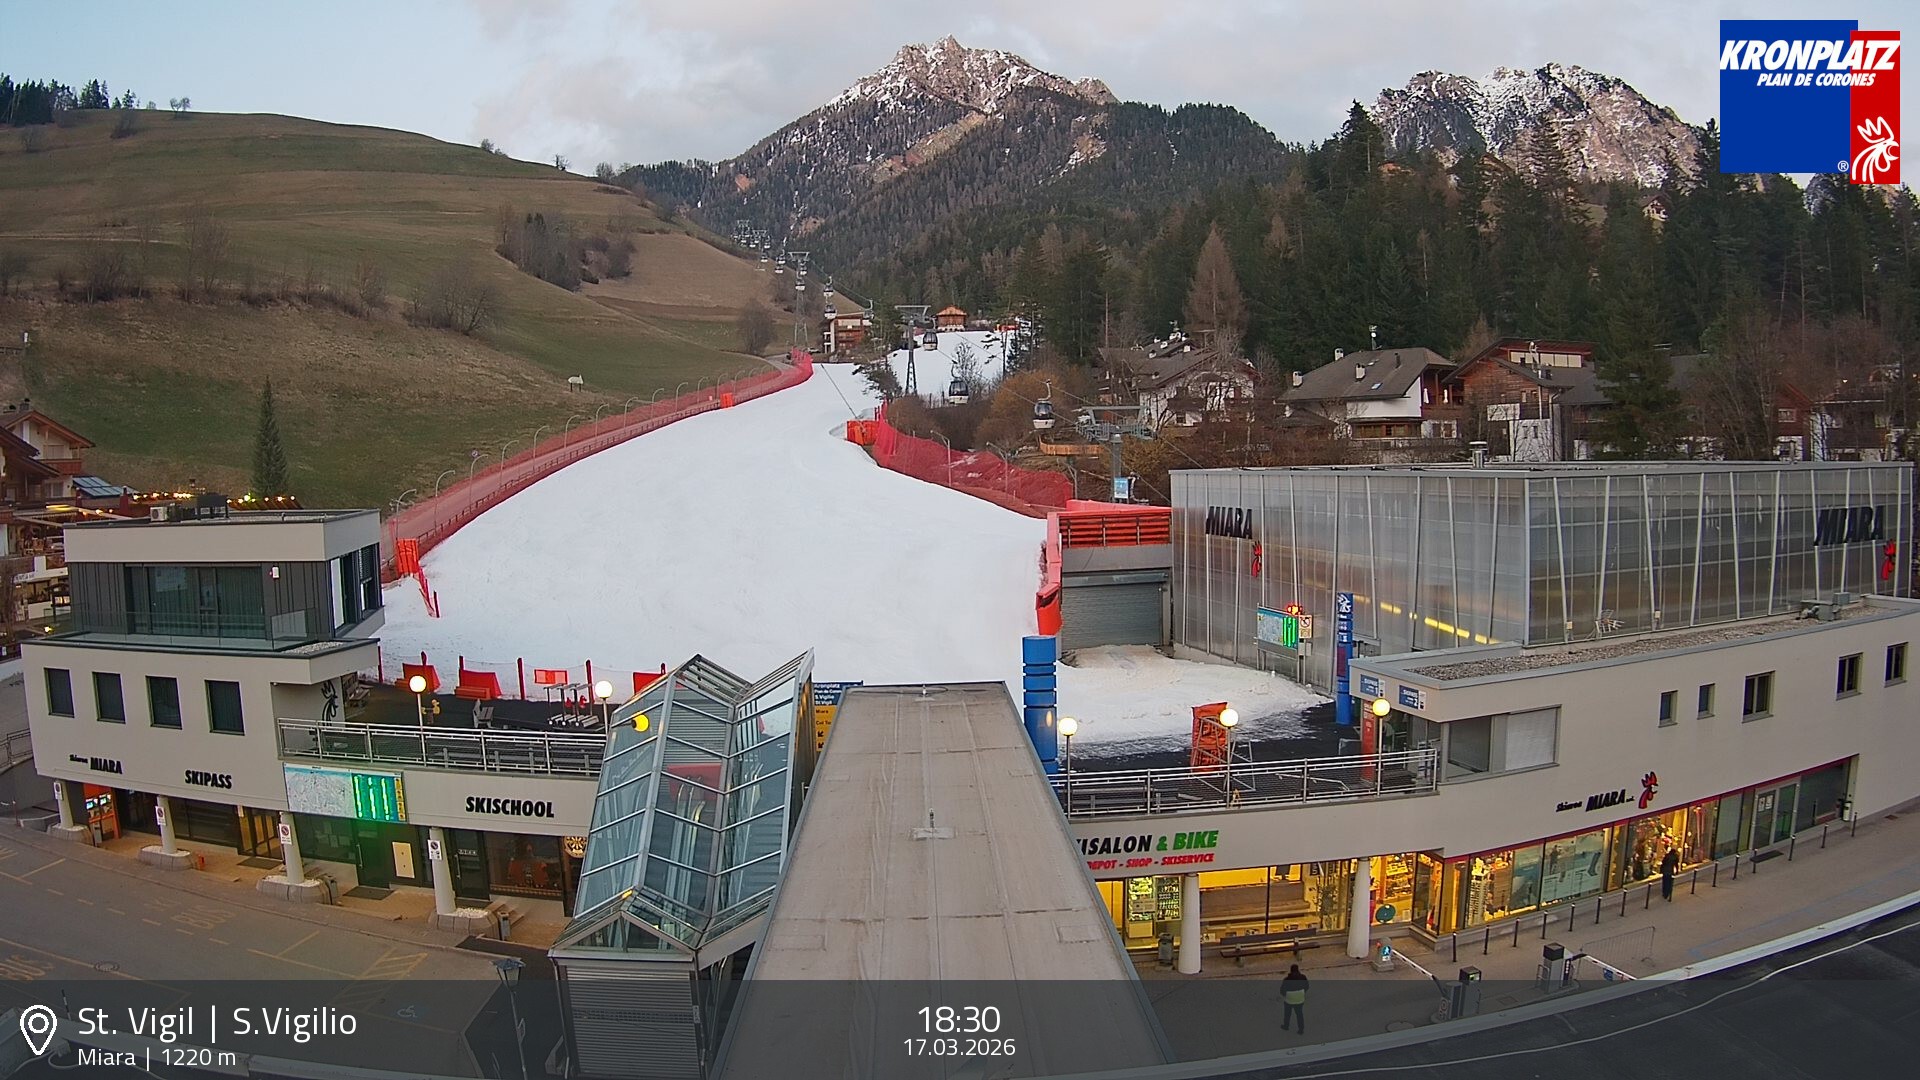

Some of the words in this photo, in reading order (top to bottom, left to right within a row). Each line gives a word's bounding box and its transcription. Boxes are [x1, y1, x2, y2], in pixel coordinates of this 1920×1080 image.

[1205, 505, 1252, 540] MIARA
[1814, 505, 1884, 547] MIARA
[90, 757, 123, 775] MIARA
[185, 770, 232, 790] SKIPASS
[466, 796, 554, 818] SKISCHOOL
[1585, 788, 1626, 812] MIARA
[1077, 835, 1152, 855] ISALON
[1156, 836, 1168, 851] &
[1172, 830, 1219, 850] BIKE
[1126, 858, 1152, 868] SHOP
[1161, 853, 1215, 866] SKISERVICE
